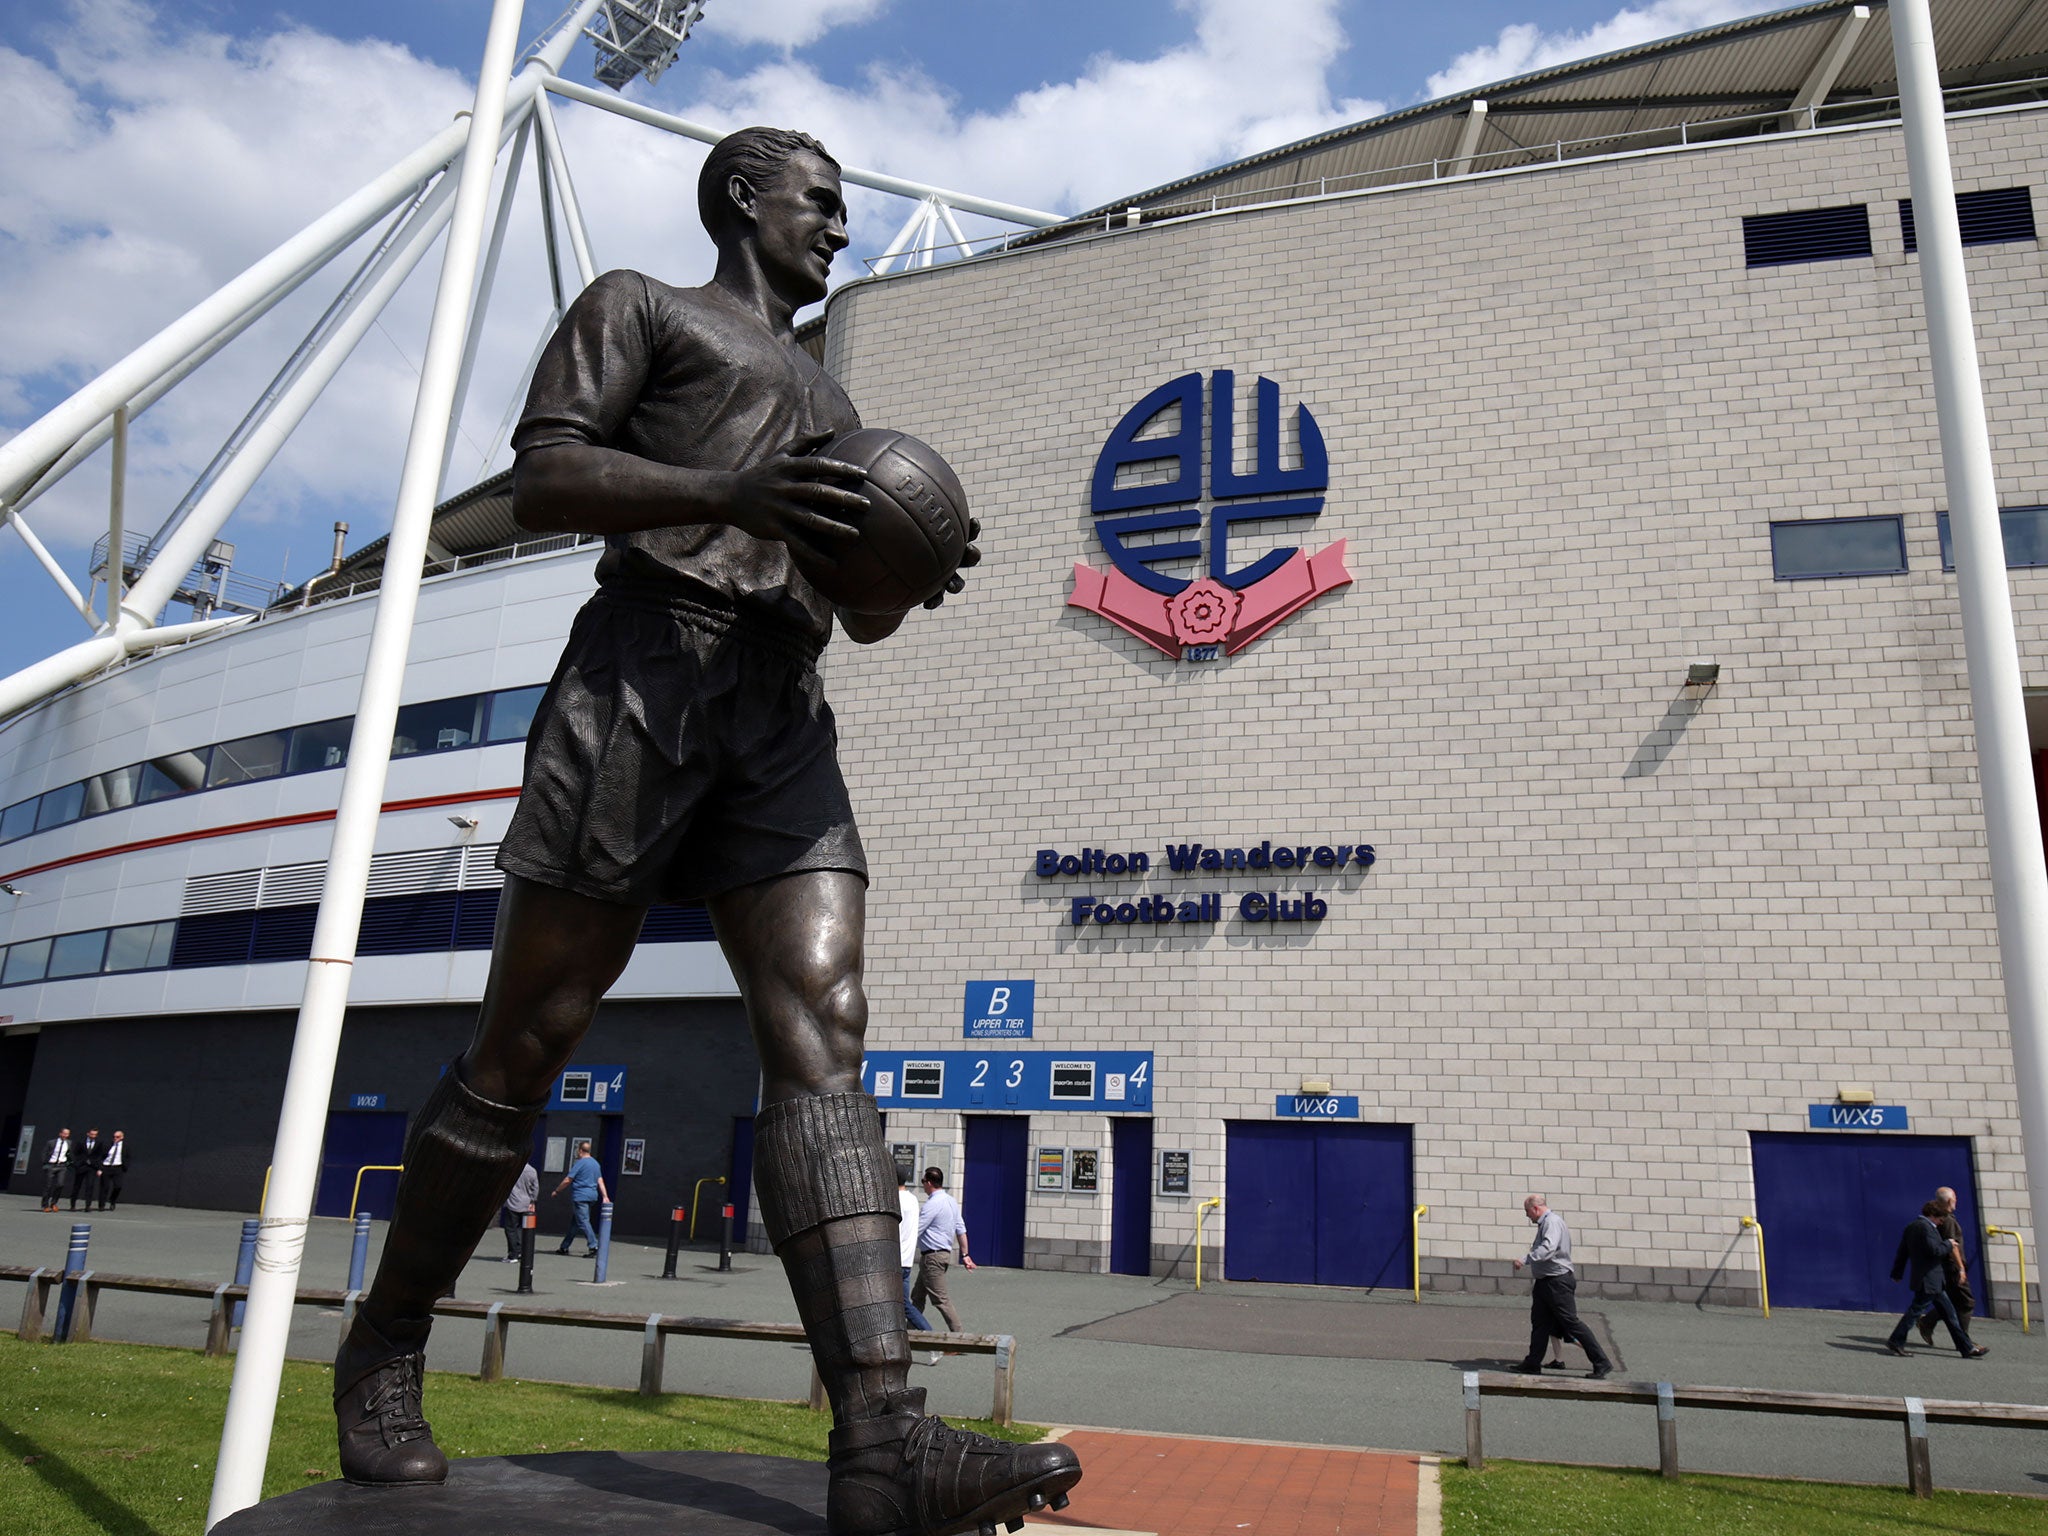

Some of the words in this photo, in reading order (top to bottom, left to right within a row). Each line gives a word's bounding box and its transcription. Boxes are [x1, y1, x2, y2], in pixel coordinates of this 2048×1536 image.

[1186, 647, 1218, 662] 1877
[1036, 847, 1149, 876] Bolton
[1166, 841, 1376, 871] Wanderers
[1072, 893, 1221, 925] Football
[1239, 891, 1327, 922] Club
[988, 987, 1010, 1015] B
[973, 1019, 1001, 1028] UPPER
[1006, 1019, 1025, 1028] TIER
[610, 1071, 624, 1093] 4
[970, 1060, 989, 1087] 2
[1005, 1060, 1024, 1088] 3
[1129, 1060, 1148, 1088] 4
[357, 1096, 378, 1106] WX8
[1293, 1097, 1339, 1115] WX6
[1831, 1106, 1884, 1126] WX5
